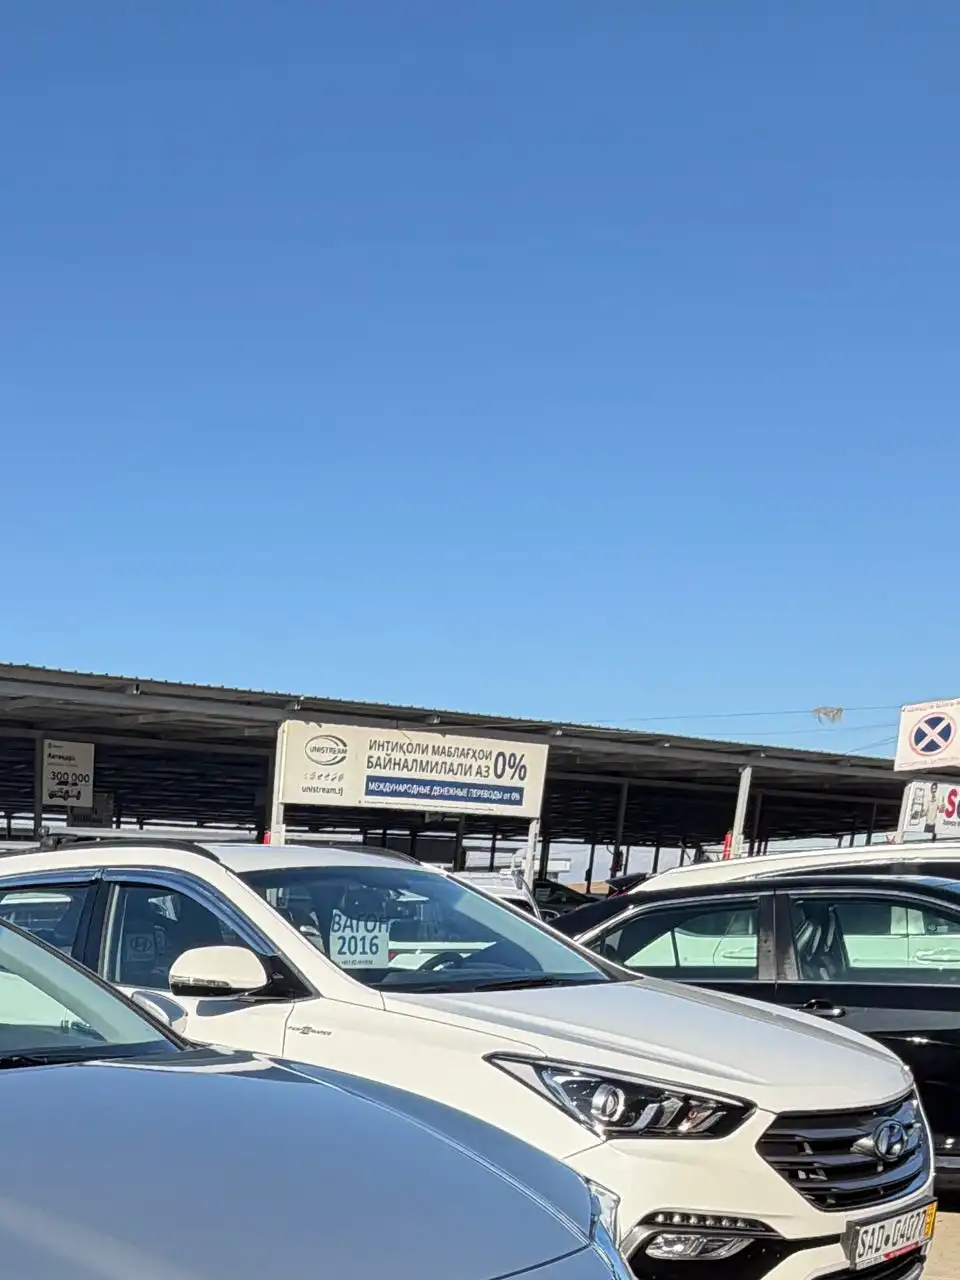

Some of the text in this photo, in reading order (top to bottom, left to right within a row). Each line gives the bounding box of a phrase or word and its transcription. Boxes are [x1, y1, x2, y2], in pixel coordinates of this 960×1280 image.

[309, 745, 348, 755] UNISTREAM
[368, 739, 493, 762] ИНТИҚОЛИ МАБЛАҒҲОИ
[366, 752, 491, 779] БАЙНАЛМИЛАЛИ АЗ
[493, 751, 528, 781] 0%
[51, 771, 90, 783] 300 000
[301, 785, 344, 797] unistream.tj
[368, 781, 521, 801] МЕЖДУНАРОДНЫЕ ДЕНЕЖНЫЕ ПЕРЕВОДЫ от 0%
[944, 788, 960, 820] S
[331, 913, 389, 933] ВАГОН
[337, 935, 379, 956] 2016
[857, 1224, 886, 1259] SAD
